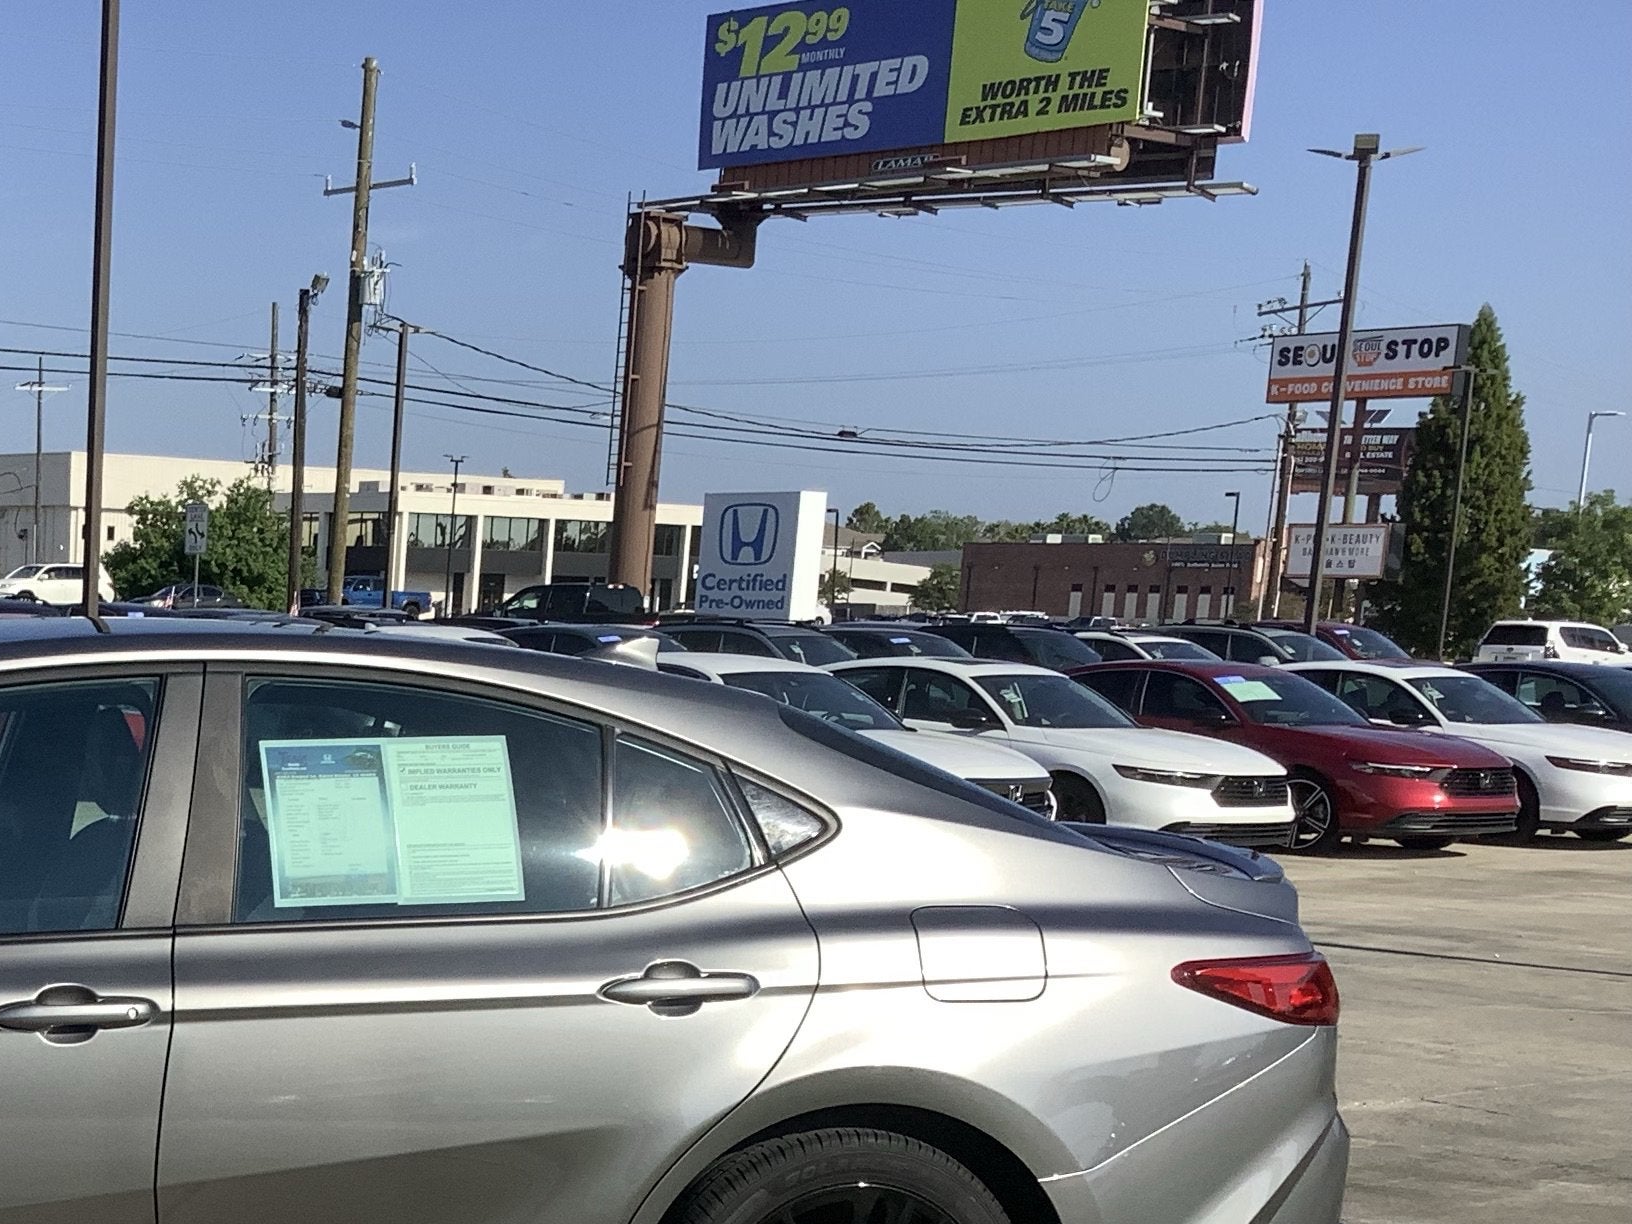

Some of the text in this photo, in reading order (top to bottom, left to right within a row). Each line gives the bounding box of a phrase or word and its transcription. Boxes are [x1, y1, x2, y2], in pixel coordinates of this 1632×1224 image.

[1035, 10, 1071, 46] 5
[801, 47, 846, 64] MONTHLY
[712, 55, 929, 118] UNLIMITED
[981, 68, 1110, 101] WORTH THE
[959, 88, 1129, 126] EXTRA 2 MILES
[712, 101, 873, 155] WASHES
[1277, 337, 1450, 367] SEOU STOP
[1270, 376, 1449, 396] K-FOOD COVENIENCE STORE
[1330, 533, 1380, 544] K-BEAUTY
[701, 573, 787, 591] Certified
[699, 595, 785, 609] Pre-Owned
